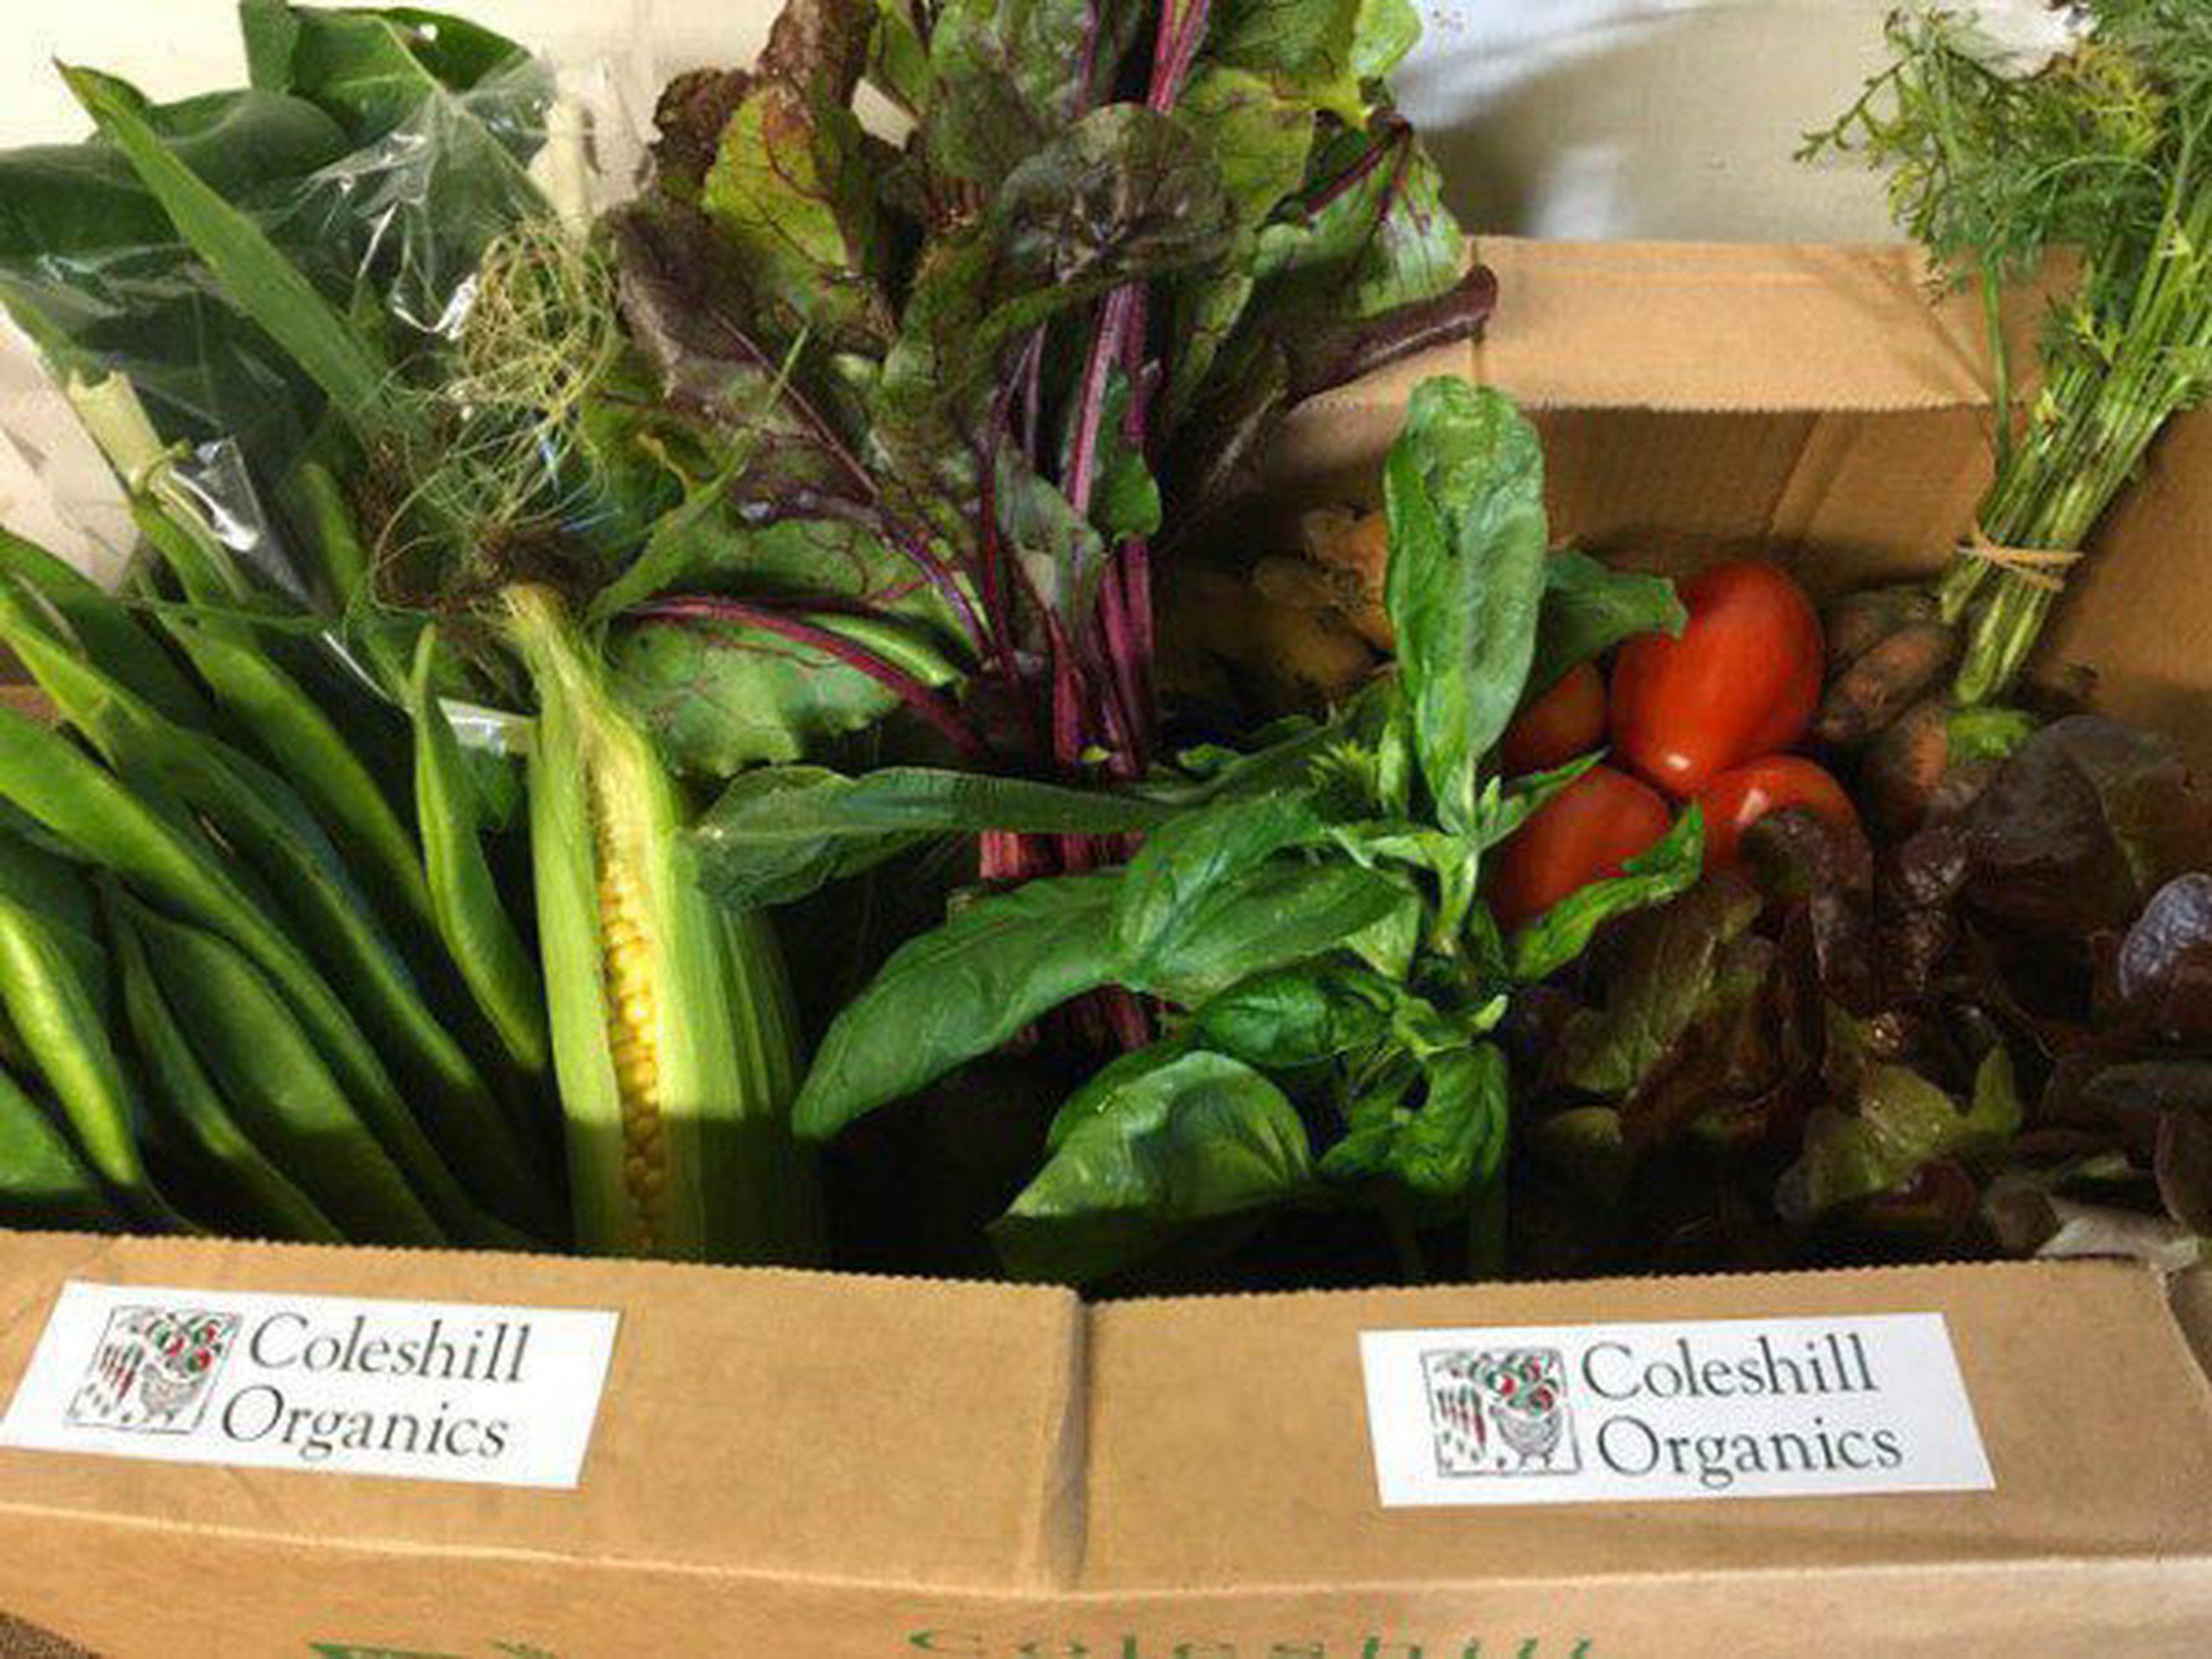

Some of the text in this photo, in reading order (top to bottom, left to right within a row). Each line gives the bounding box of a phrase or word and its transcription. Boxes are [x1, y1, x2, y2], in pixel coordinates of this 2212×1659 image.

[250, 1311, 531, 1382] Coleshill
[1582, 1332, 1879, 1400] Coleshill
[221, 1385, 509, 1460] Organics
[1597, 1416, 1903, 1489] Organics
